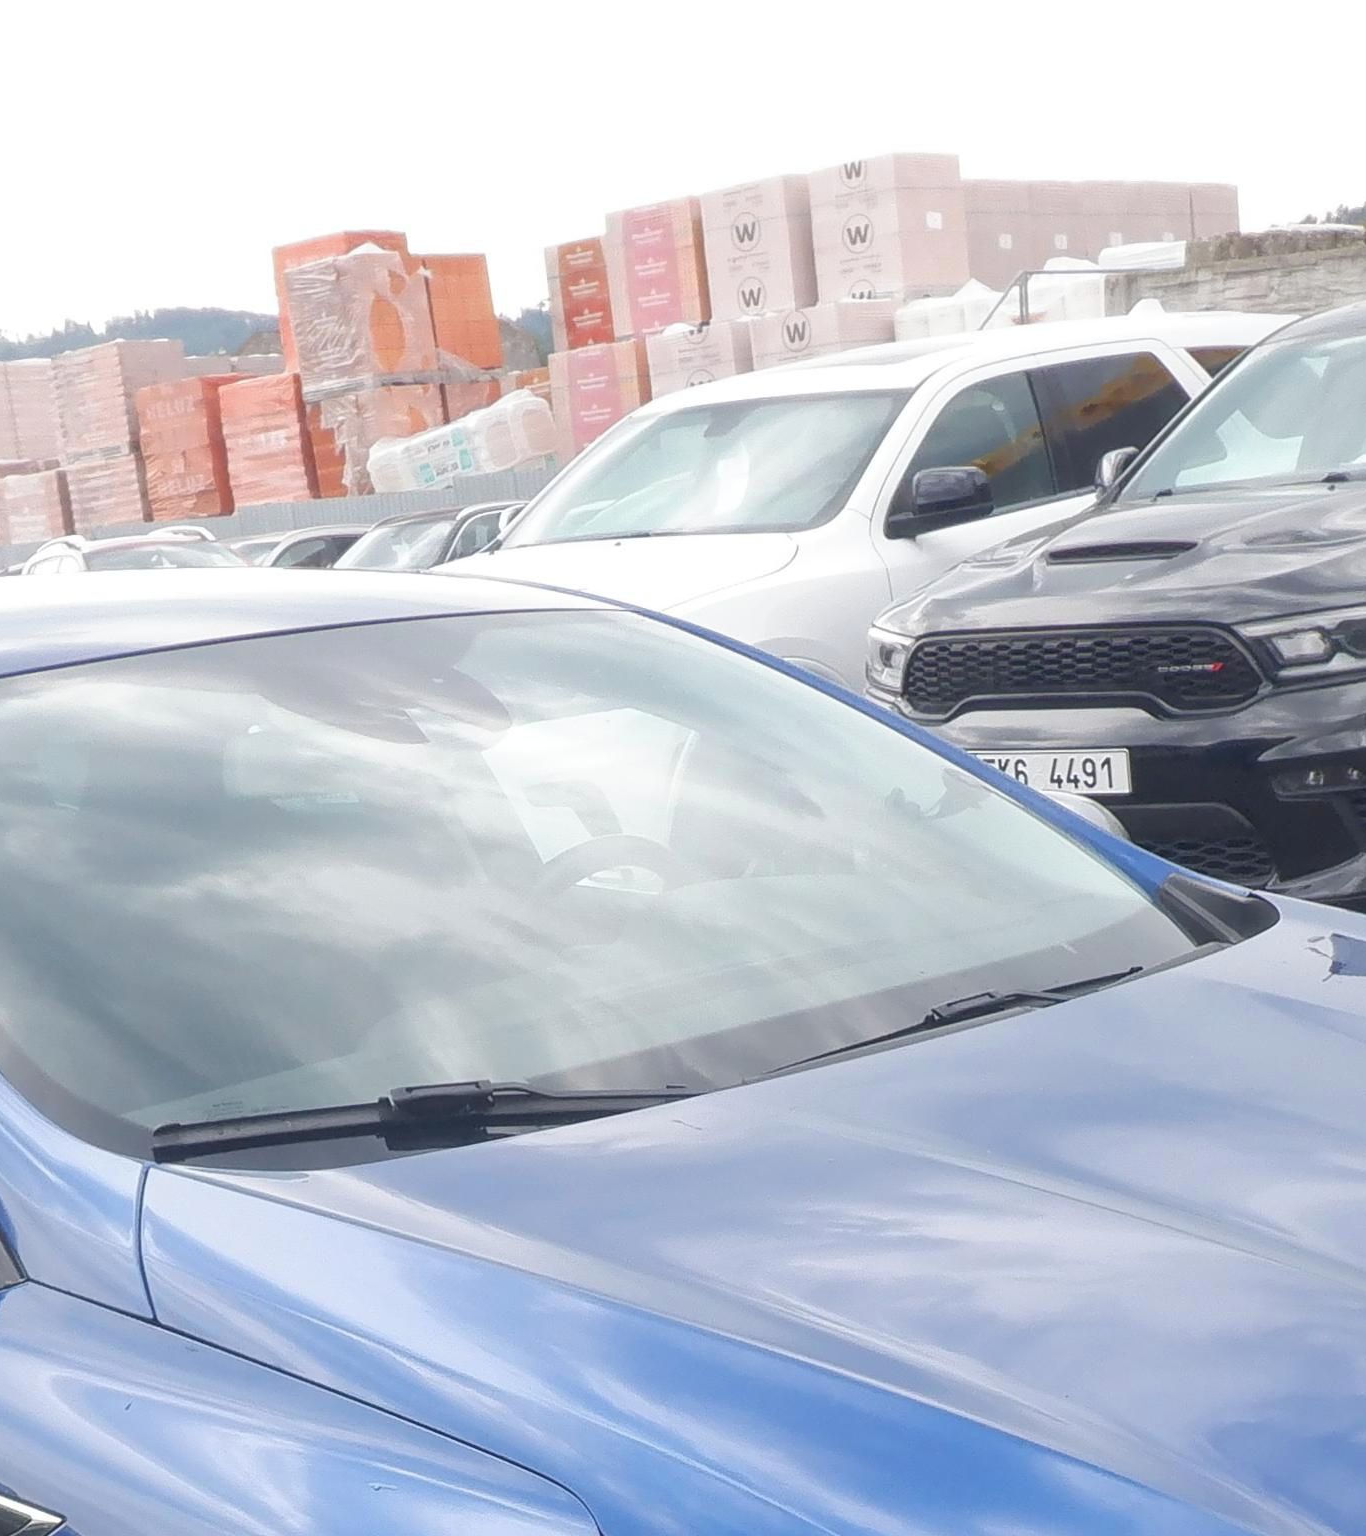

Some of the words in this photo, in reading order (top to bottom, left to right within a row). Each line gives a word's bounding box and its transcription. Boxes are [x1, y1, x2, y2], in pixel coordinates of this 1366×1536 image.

[735, 221, 756, 243] W
[846, 223, 870, 246] W
[741, 286, 762, 308] W
[785, 320, 806, 344] W
[1049, 757, 1113, 789] 4491
